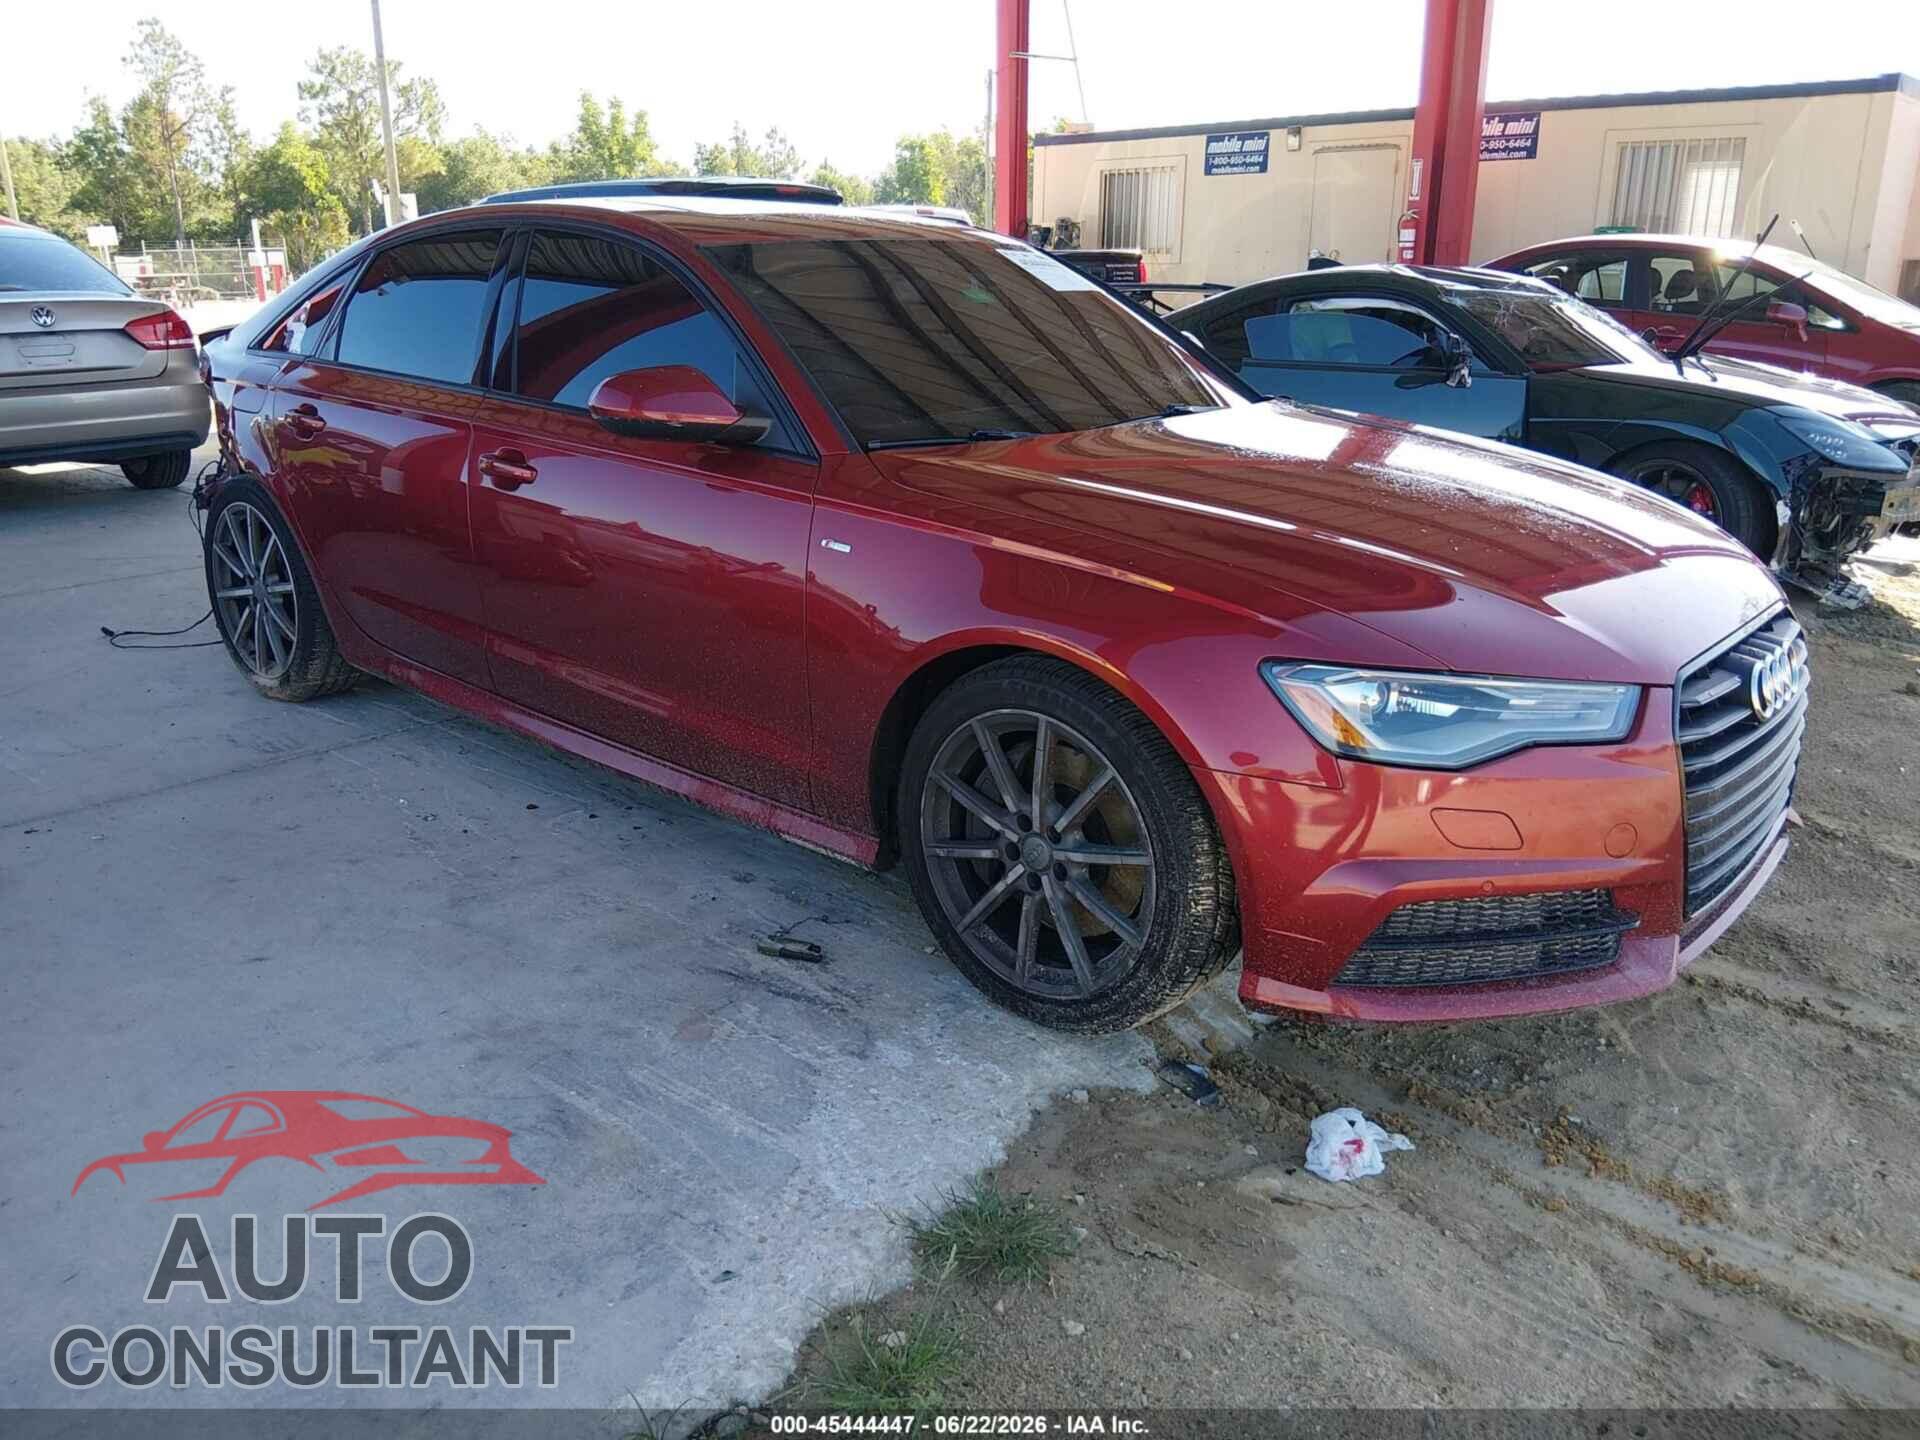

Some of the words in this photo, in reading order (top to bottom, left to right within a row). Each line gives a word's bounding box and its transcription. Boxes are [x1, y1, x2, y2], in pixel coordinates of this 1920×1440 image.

[1481, 117, 1504, 137] bile
[1504, 118, 1538, 135] mini
[1207, 135, 1242, 153] mobile
[1242, 135, 1268, 152] mini
